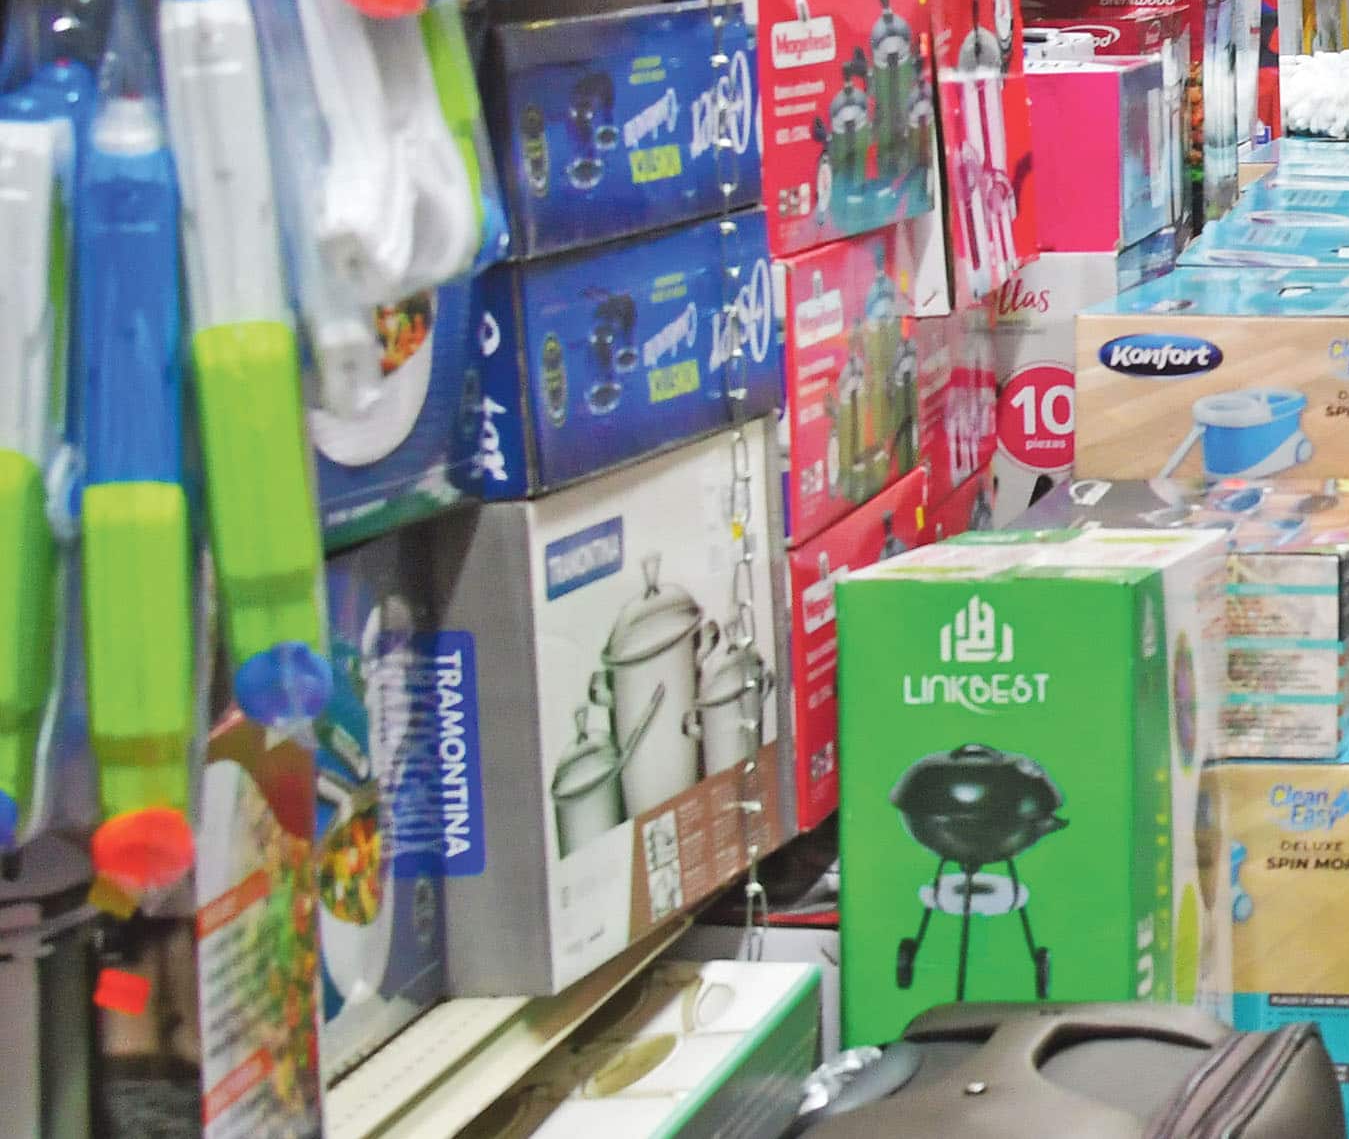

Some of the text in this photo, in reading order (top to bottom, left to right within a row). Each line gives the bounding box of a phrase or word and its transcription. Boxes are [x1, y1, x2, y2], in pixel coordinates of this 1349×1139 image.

[1110, 344, 1213, 371] Konfort
[1011, 384, 1075, 436] 10
[1025, 437, 1067, 452] piezas
[905, 673, 1049, 710] LINKBEST
[436, 649, 473, 858] TRAMONTINA
[1270, 784, 1329, 809] Clean
[1291, 804, 1341, 830] Easy
[1281, 841, 1344, 851] DELUXE
[1267, 858, 1309, 871] SPIN
